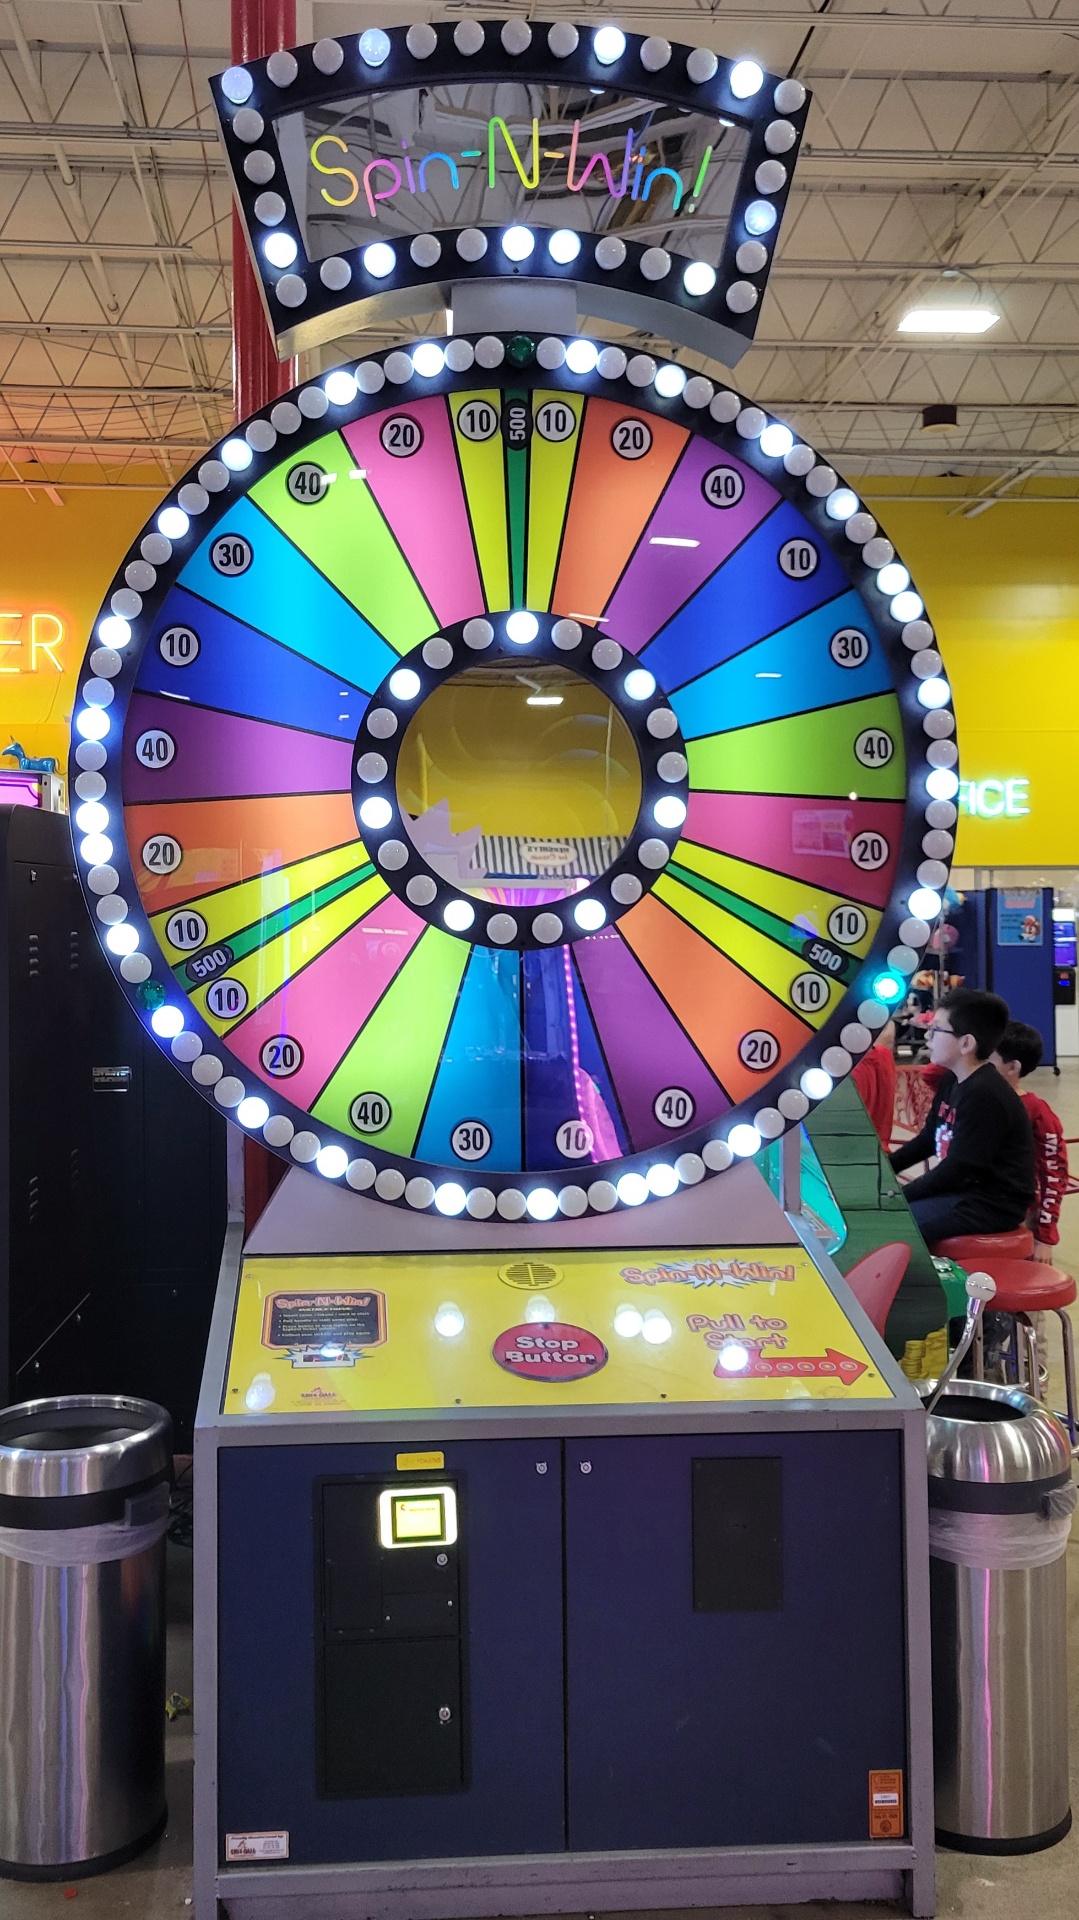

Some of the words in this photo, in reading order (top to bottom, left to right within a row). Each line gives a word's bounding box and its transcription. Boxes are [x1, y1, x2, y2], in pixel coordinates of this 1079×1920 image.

[309, 115, 714, 218] Spin-N-Win!
[467, 410, 490, 432] 10
[509, 407, 527, 441] 500
[543, 410, 566, 432] 10
[390, 424, 414, 447] 20
[619, 427, 643, 450] 20
[295, 472, 320, 495] 40
[711, 476, 735, 498] 40
[219, 544, 244, 566] 30
[787, 548, 810, 570] 10
[166, 634, 190, 657] 10
[838, 637, 862, 659] 30
[142, 738, 168, 761] 40
[864, 737, 888, 759] 40
[149, 843, 174, 865] 20
[858, 839, 882, 862] 20
[175, 918, 199, 942] 10
[836, 913, 858, 935] 10
[191, 948, 228, 978] 500
[808, 942, 843, 972] 500
[215, 988, 238, 1011] 10
[797, 982, 820, 1003] 10
[269, 1045, 294, 1068] 20
[747, 1040, 771, 1063] 20
[358, 1102, 383, 1125] 40
[662, 1097, 686, 1120] 40
[459, 1128, 484, 1150] 30
[563, 1127, 586, 1150] 10
[619, 1262, 796, 1285] Spin-N-Win!
[686, 1313, 746, 1332] Pull
[749, 1314, 788, 1331] to
[515, 1336, 579, 1351] Stop
[504, 1350, 597, 1363] Button
